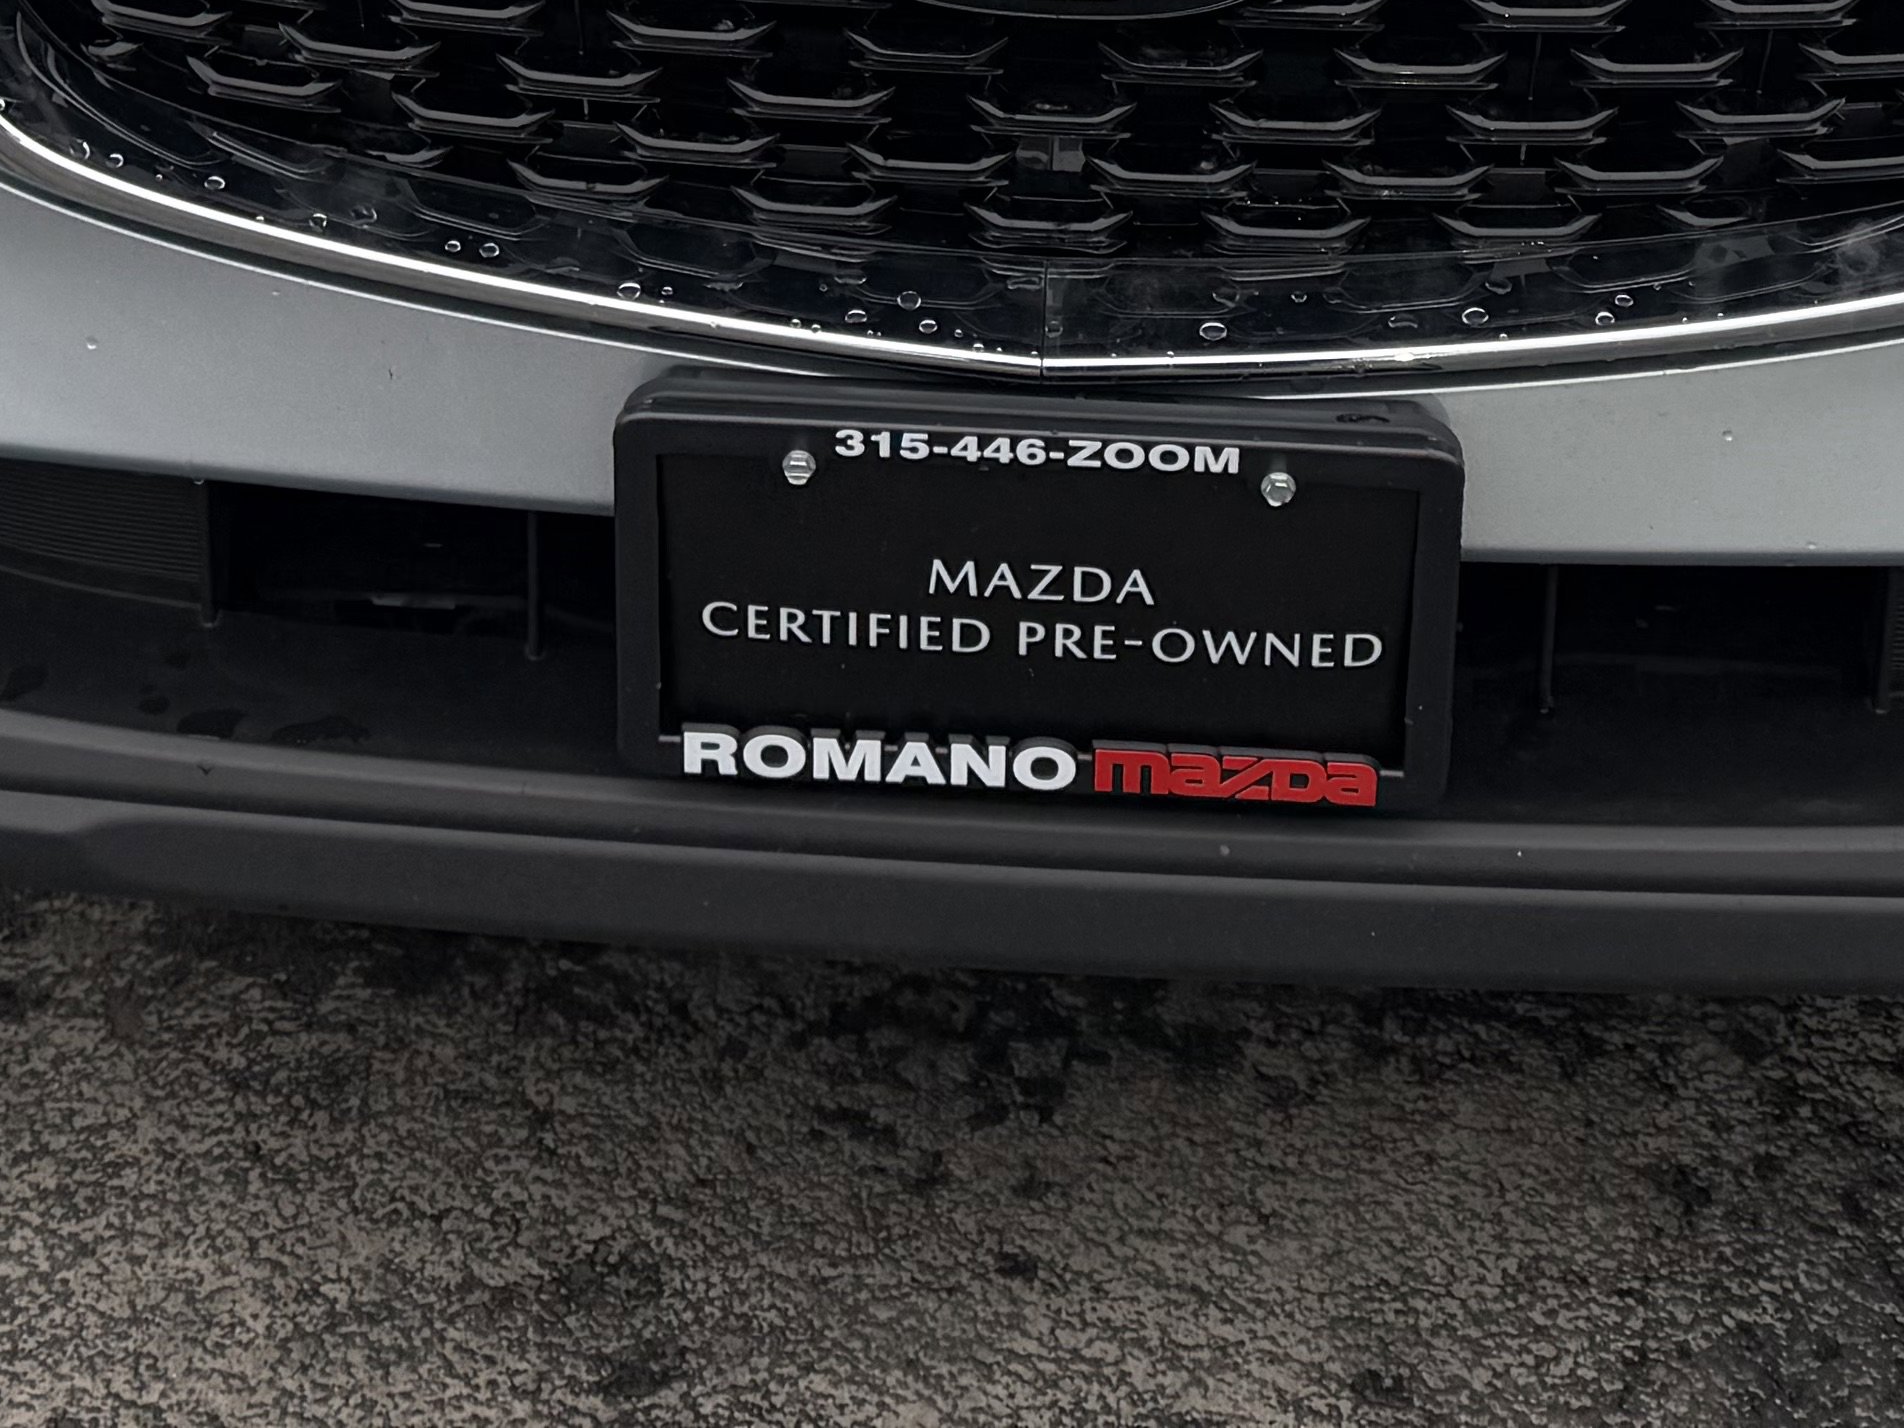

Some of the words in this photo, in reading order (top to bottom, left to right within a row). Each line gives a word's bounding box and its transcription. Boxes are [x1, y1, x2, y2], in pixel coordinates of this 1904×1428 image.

[834, 429, 1241, 474] 315-446-ZOOM
[928, 558, 1156, 605] MAZDA
[702, 601, 990, 653] CERTIFIED
[1018, 621, 1383, 667] PRE-OWNED
[683, 731, 1078, 791] ROMANO
[1094, 747, 1377, 807] mazda
